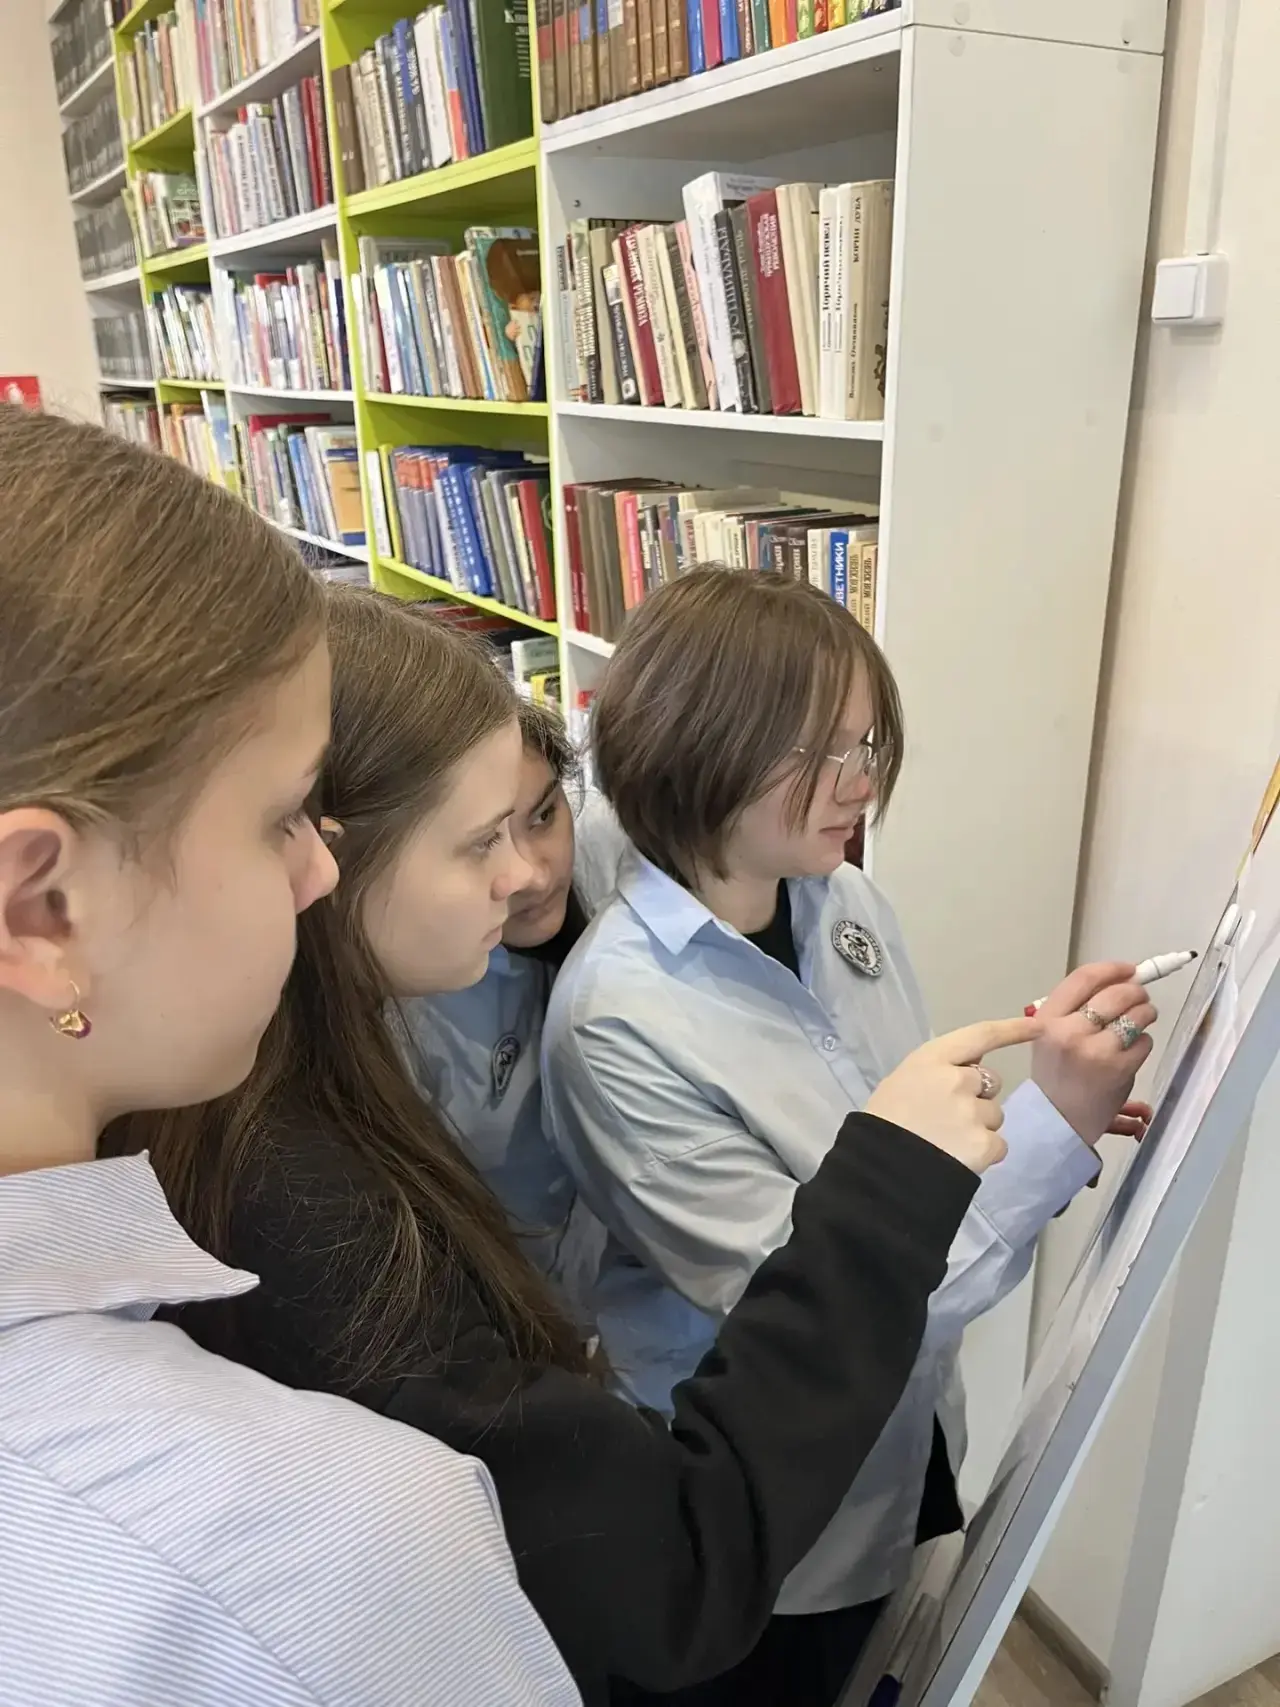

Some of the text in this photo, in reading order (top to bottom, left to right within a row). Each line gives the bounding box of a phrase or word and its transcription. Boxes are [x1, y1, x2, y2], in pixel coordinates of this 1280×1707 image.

[822, 221, 831, 258] пепел
[852, 227, 861, 263] КОРНИ
[716, 225, 744, 336] РОТШИЛЬДЫ
[821, 259, 832, 311] Горячий
[835, 542, 846, 606] ОВЕТНИКИ
[849, 554, 859, 579] ЖИЗНЬ
[863, 557, 873, 582] ЖИЗНЬ
[849, 579, 858, 594] МОЯ
[863, 582, 872, 599] МОЯ
